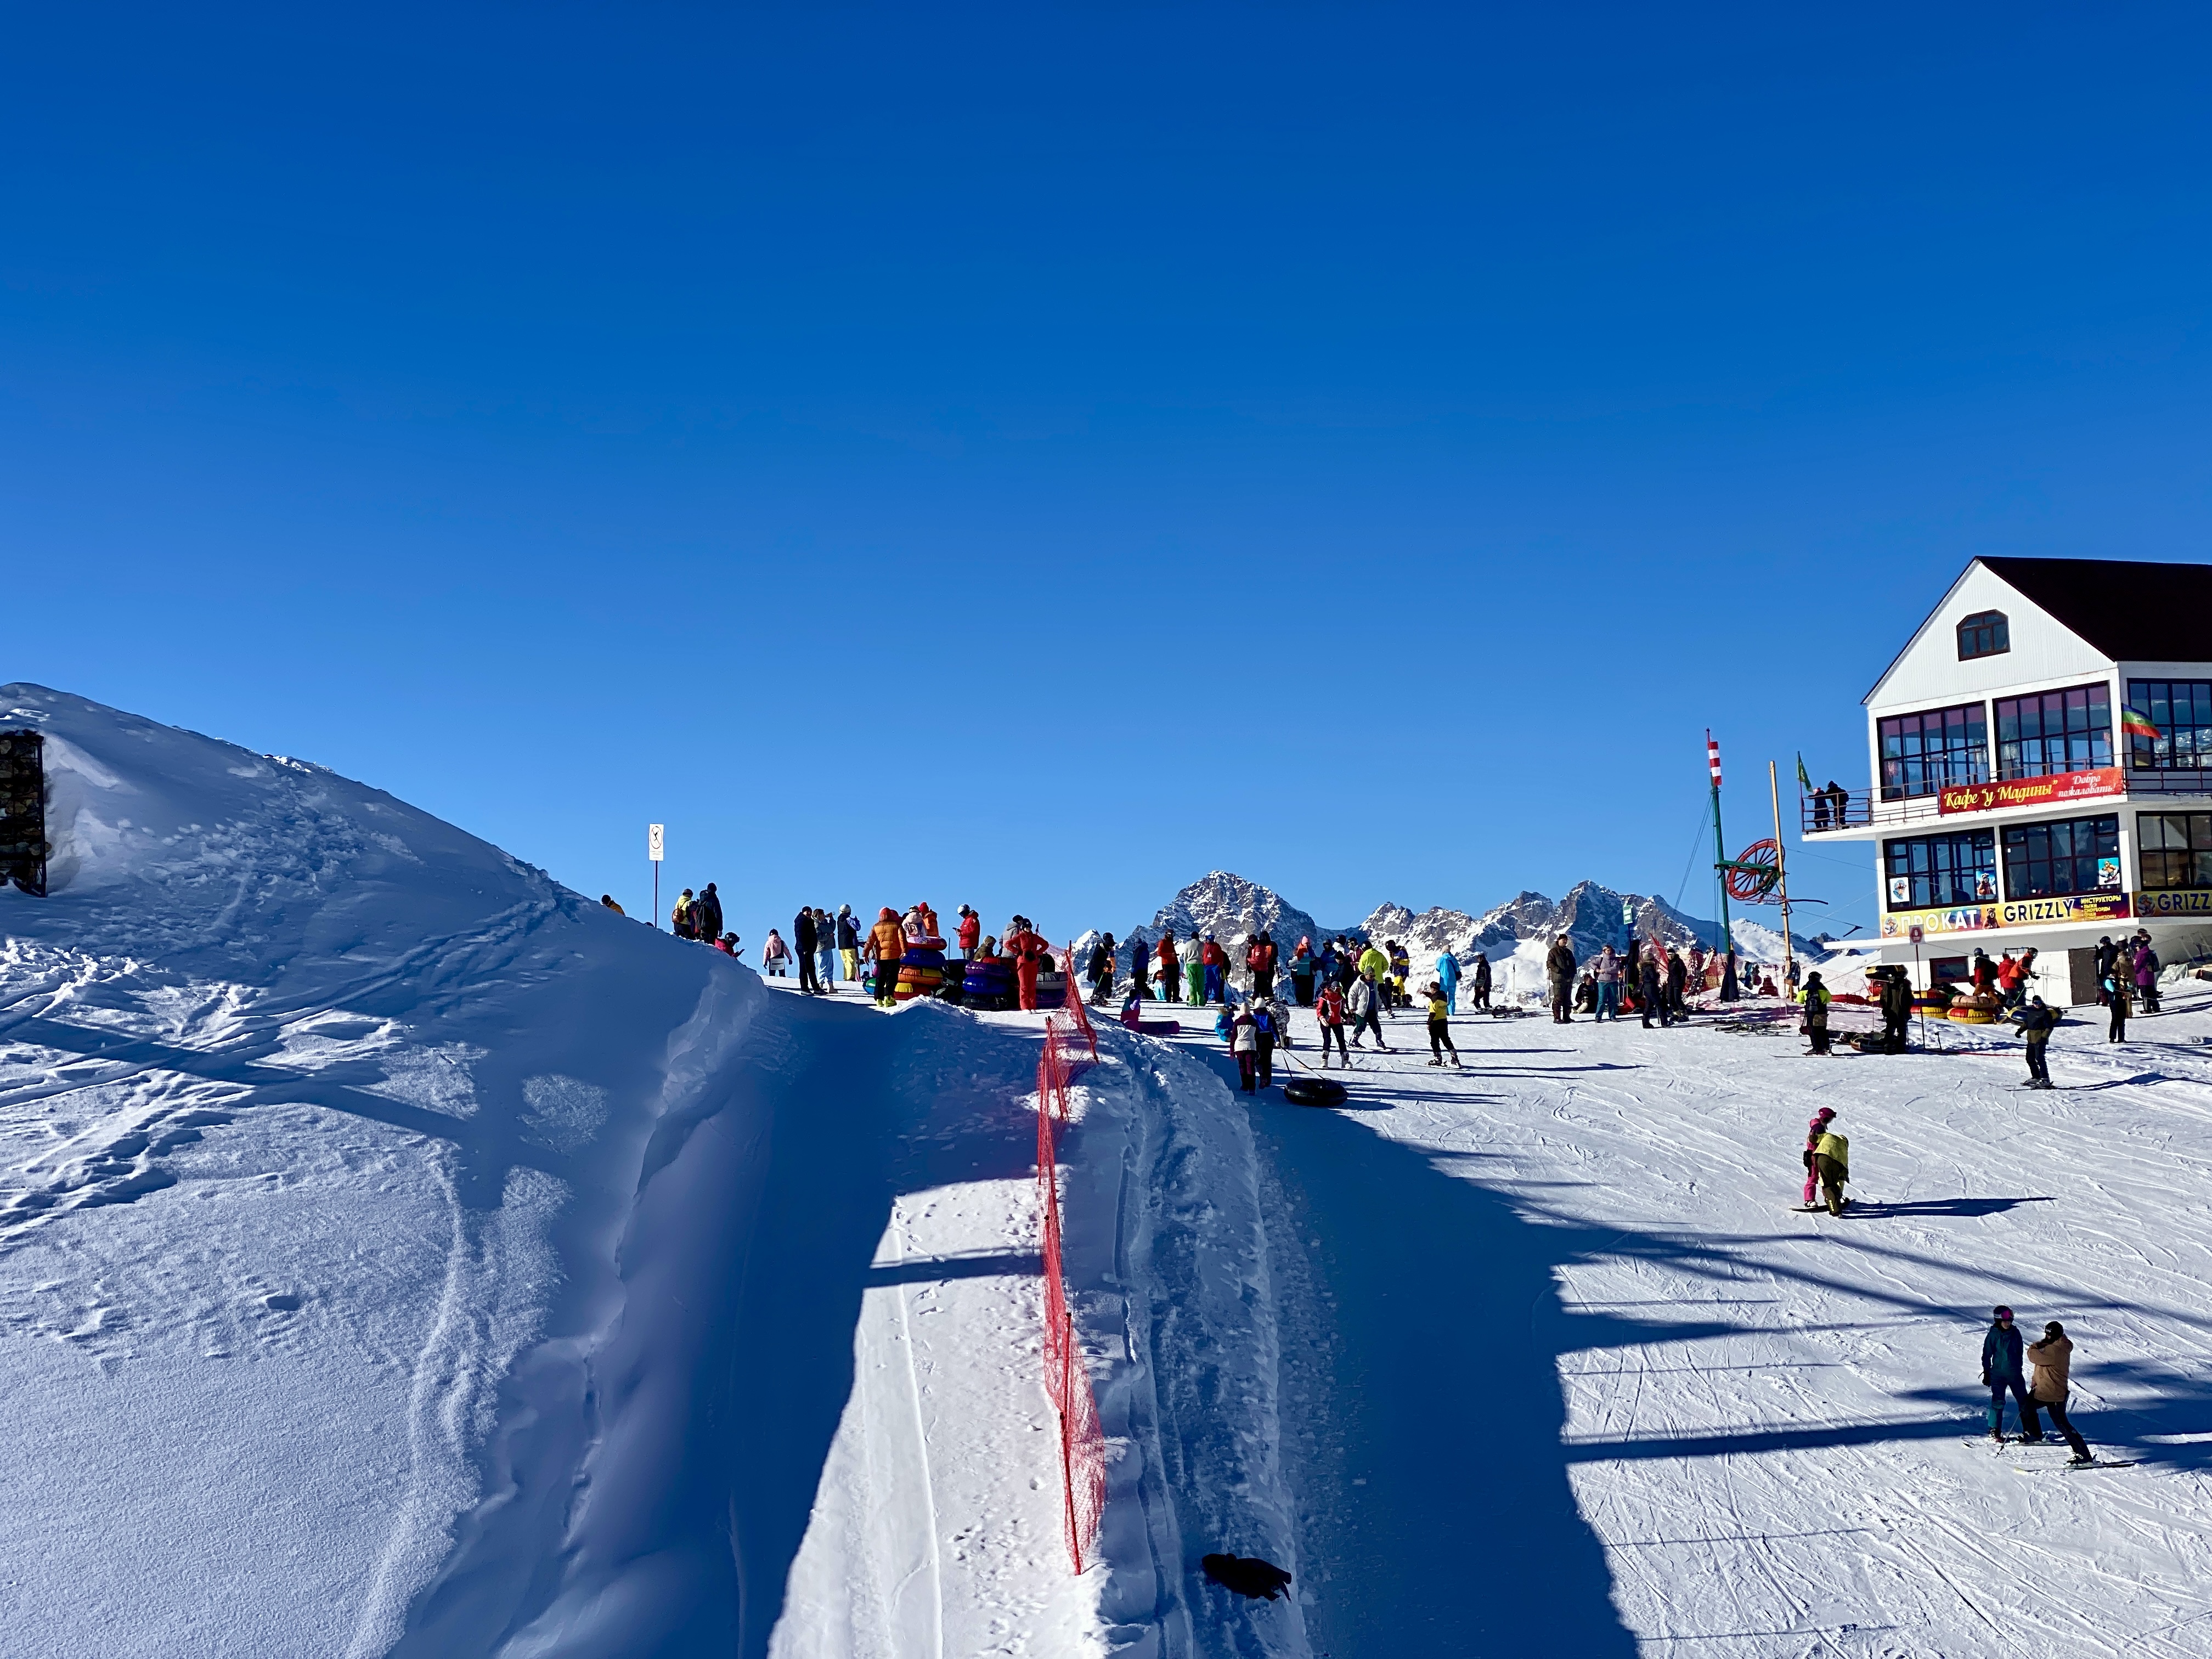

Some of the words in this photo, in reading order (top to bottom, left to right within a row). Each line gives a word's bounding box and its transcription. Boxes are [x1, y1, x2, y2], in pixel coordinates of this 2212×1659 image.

[2073, 773, 2101, 786] Добро
[2058, 783, 2116, 798] пожаловать!
[1944, 789, 1979, 809] Кафе
[2081, 895, 2121, 904] ИНСТРУКТОРЫ
[2005, 899, 2075, 922] GRIZZLY
